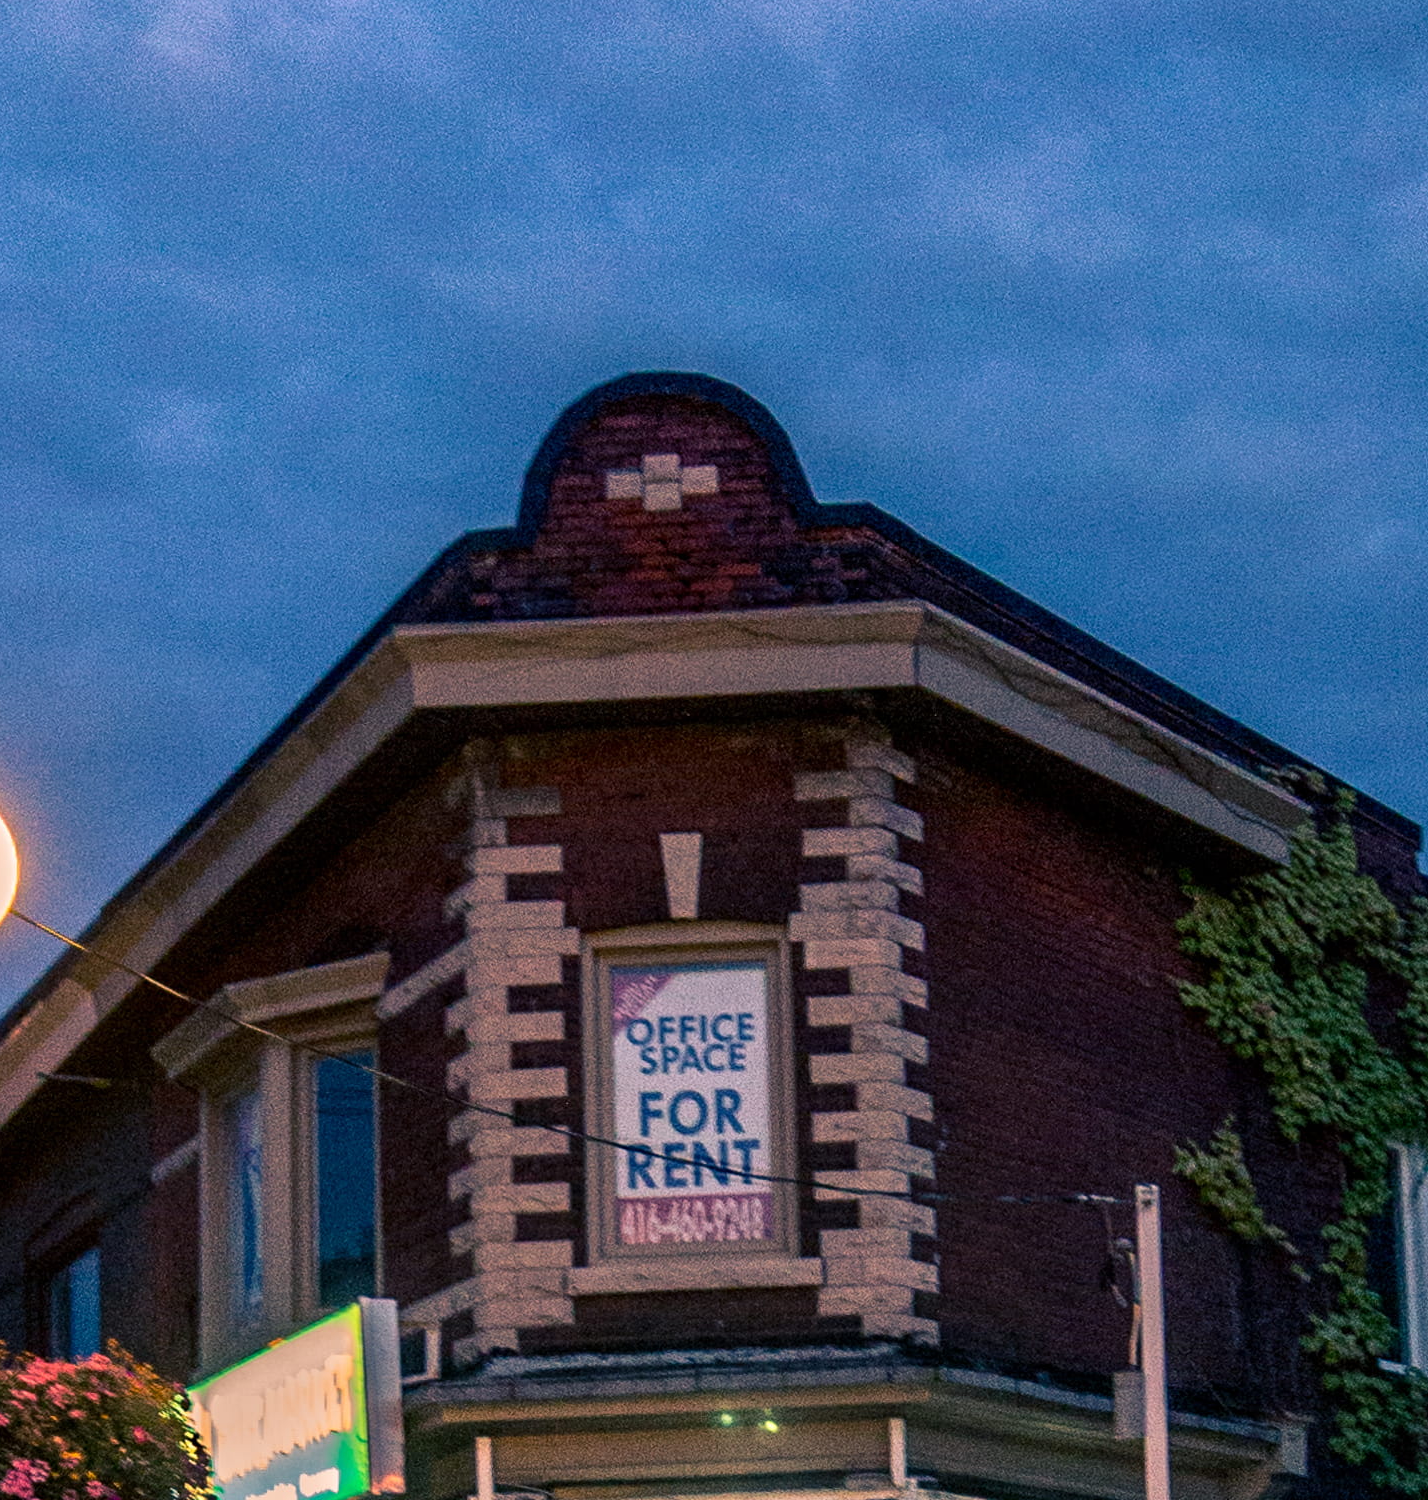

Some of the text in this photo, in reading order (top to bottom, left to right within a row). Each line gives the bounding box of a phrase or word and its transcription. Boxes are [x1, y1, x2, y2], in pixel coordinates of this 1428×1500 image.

[626, 1013, 755, 1046] OFFICE
[640, 1044, 747, 1076] SPACE
[639, 1088, 745, 1137] FOR
[627, 1138, 760, 1190] RENT
